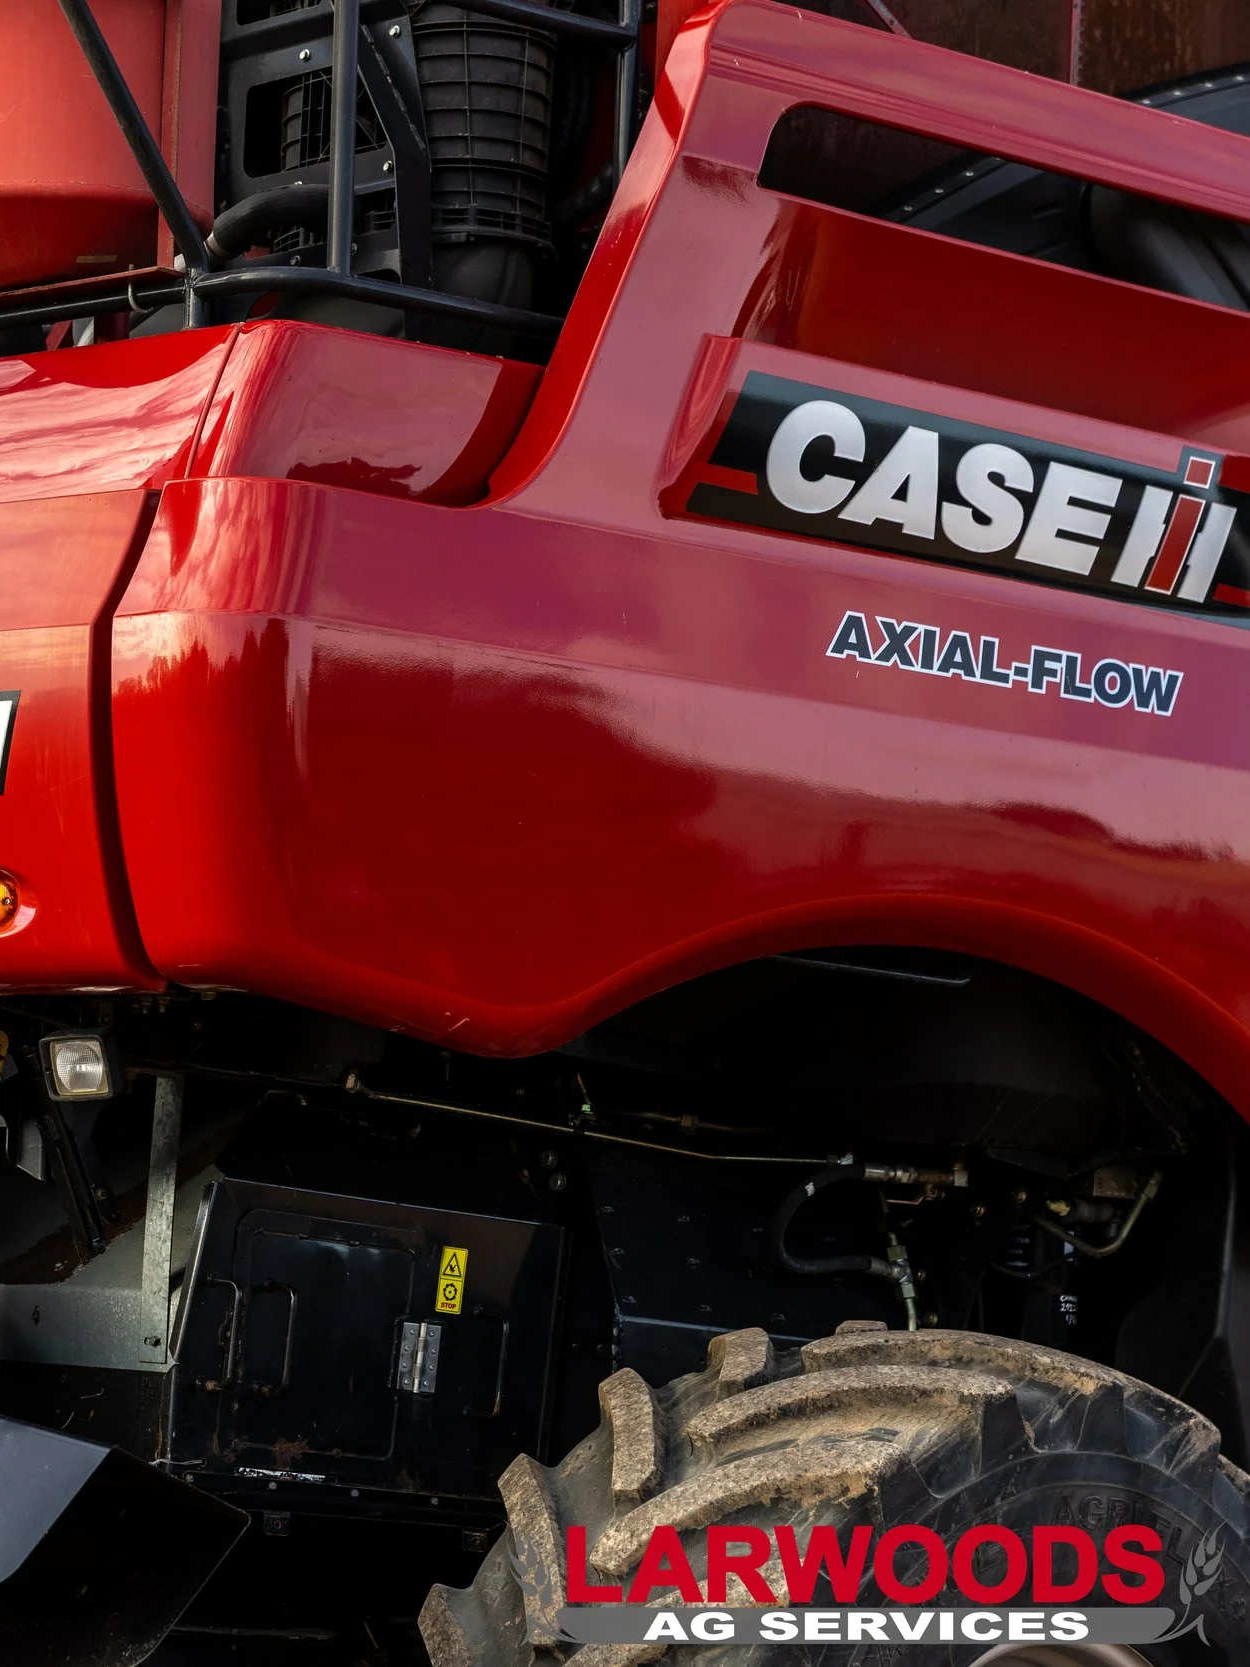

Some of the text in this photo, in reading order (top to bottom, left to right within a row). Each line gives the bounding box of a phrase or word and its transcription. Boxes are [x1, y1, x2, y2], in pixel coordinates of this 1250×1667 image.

[766, 400, 1123, 577] CASE
[825, 611, 1184, 717] AXIAL-FLOW
[440, 1301, 457, 1310] STOP
